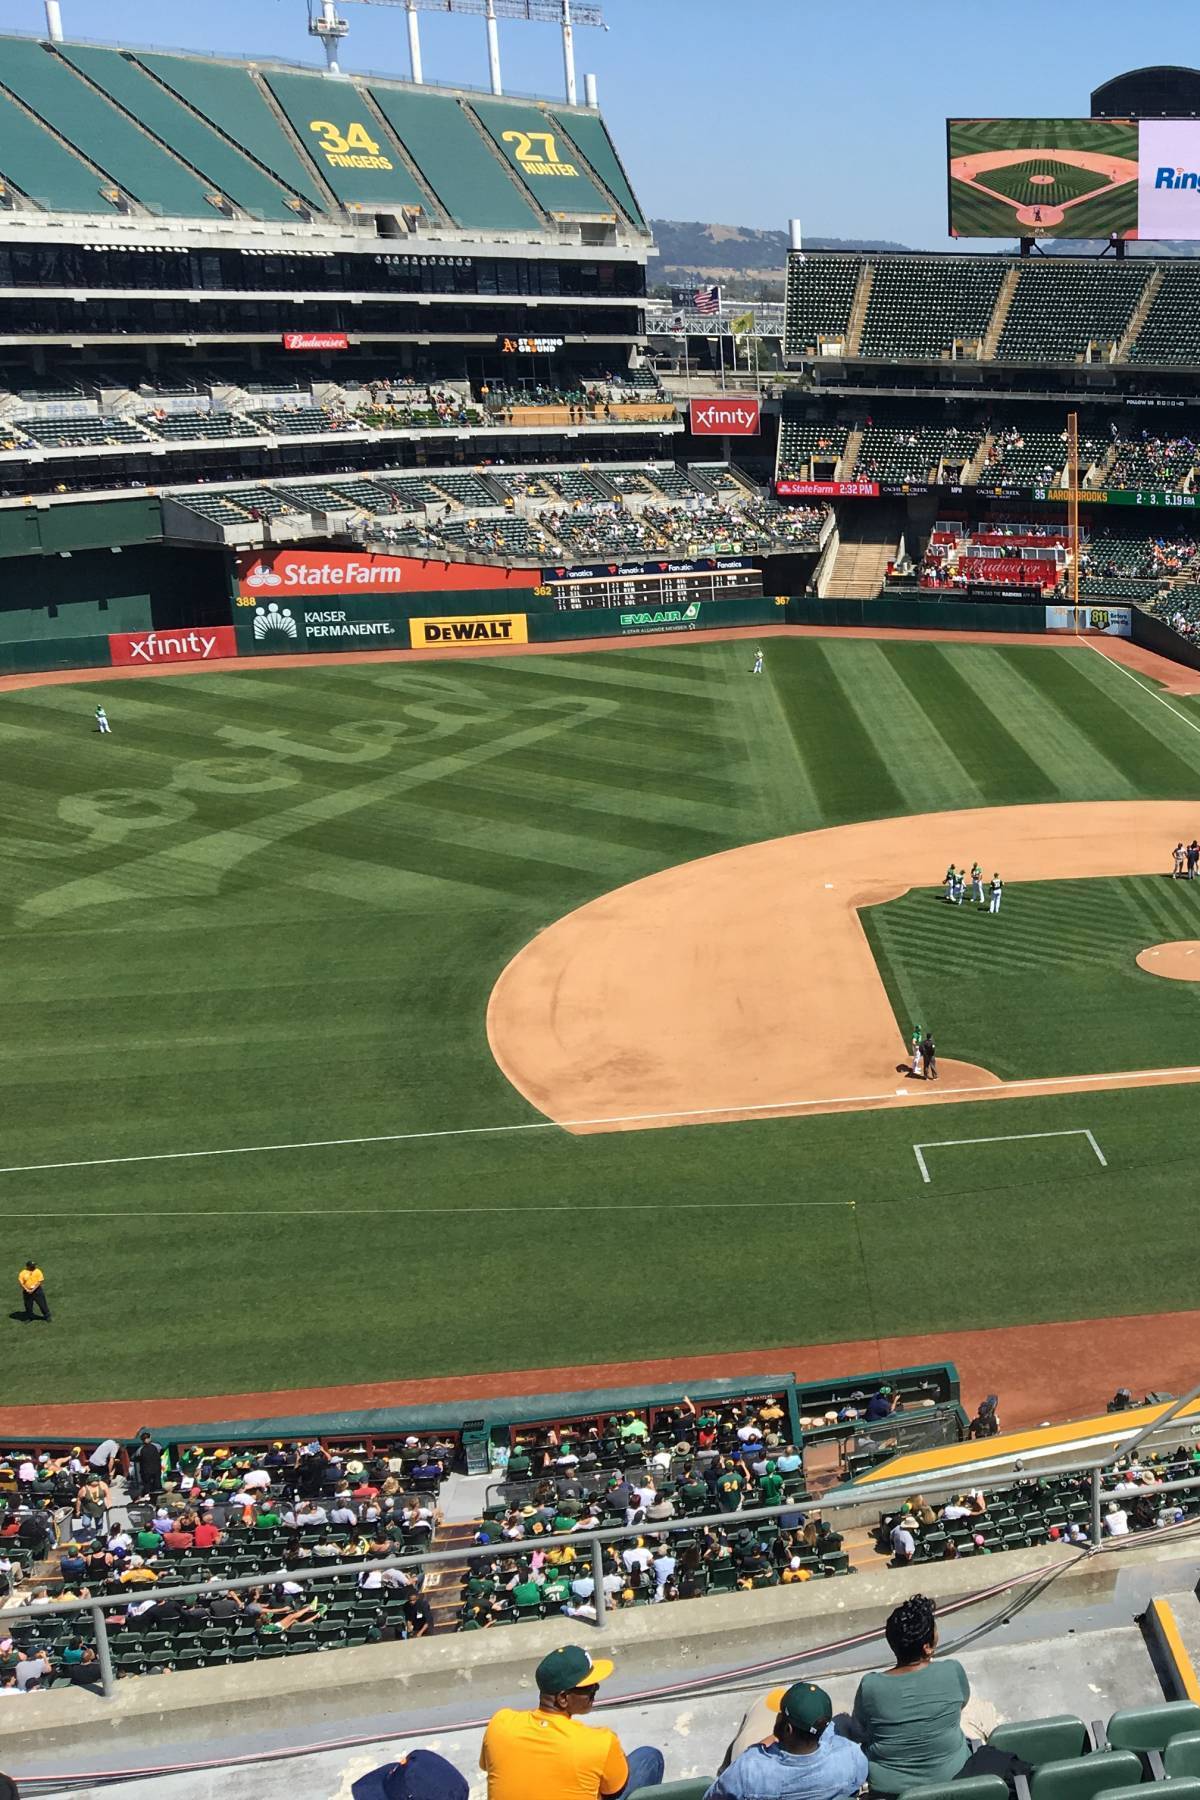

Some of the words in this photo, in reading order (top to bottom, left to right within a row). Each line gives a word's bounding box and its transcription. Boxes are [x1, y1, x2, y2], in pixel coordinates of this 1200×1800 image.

[309, 121, 379, 154] 34
[502, 131, 560, 162] 27
[326, 153, 393, 170] FINGERS
[521, 162, 579, 177] HUNTER
[287, 335, 345, 348] Budweiser
[696, 407, 756, 428] xfinity
[840, 484, 857, 494] 2:32
[859, 484, 873, 494] PM
[1034, 489, 1046, 500] 35
[1048, 490, 1076, 501] AARON
[1077, 491, 1107, 502] BROOKS
[1165, 494, 1182, 505] 5.19
[1183, 497, 1195, 506] ERA
[717, 560, 742, 569] Fanatics
[969, 558, 1040, 577] Budweiser
[534, 587, 551, 596] 362
[236, 597, 256, 607] 388
[774, 596, 790, 606] 367
[304, 611, 346, 623] KAISER
[1092, 610, 1108, 622] 811
[130, 632, 216, 661] xfinity
[723, 1480, 739, 1493] 24
